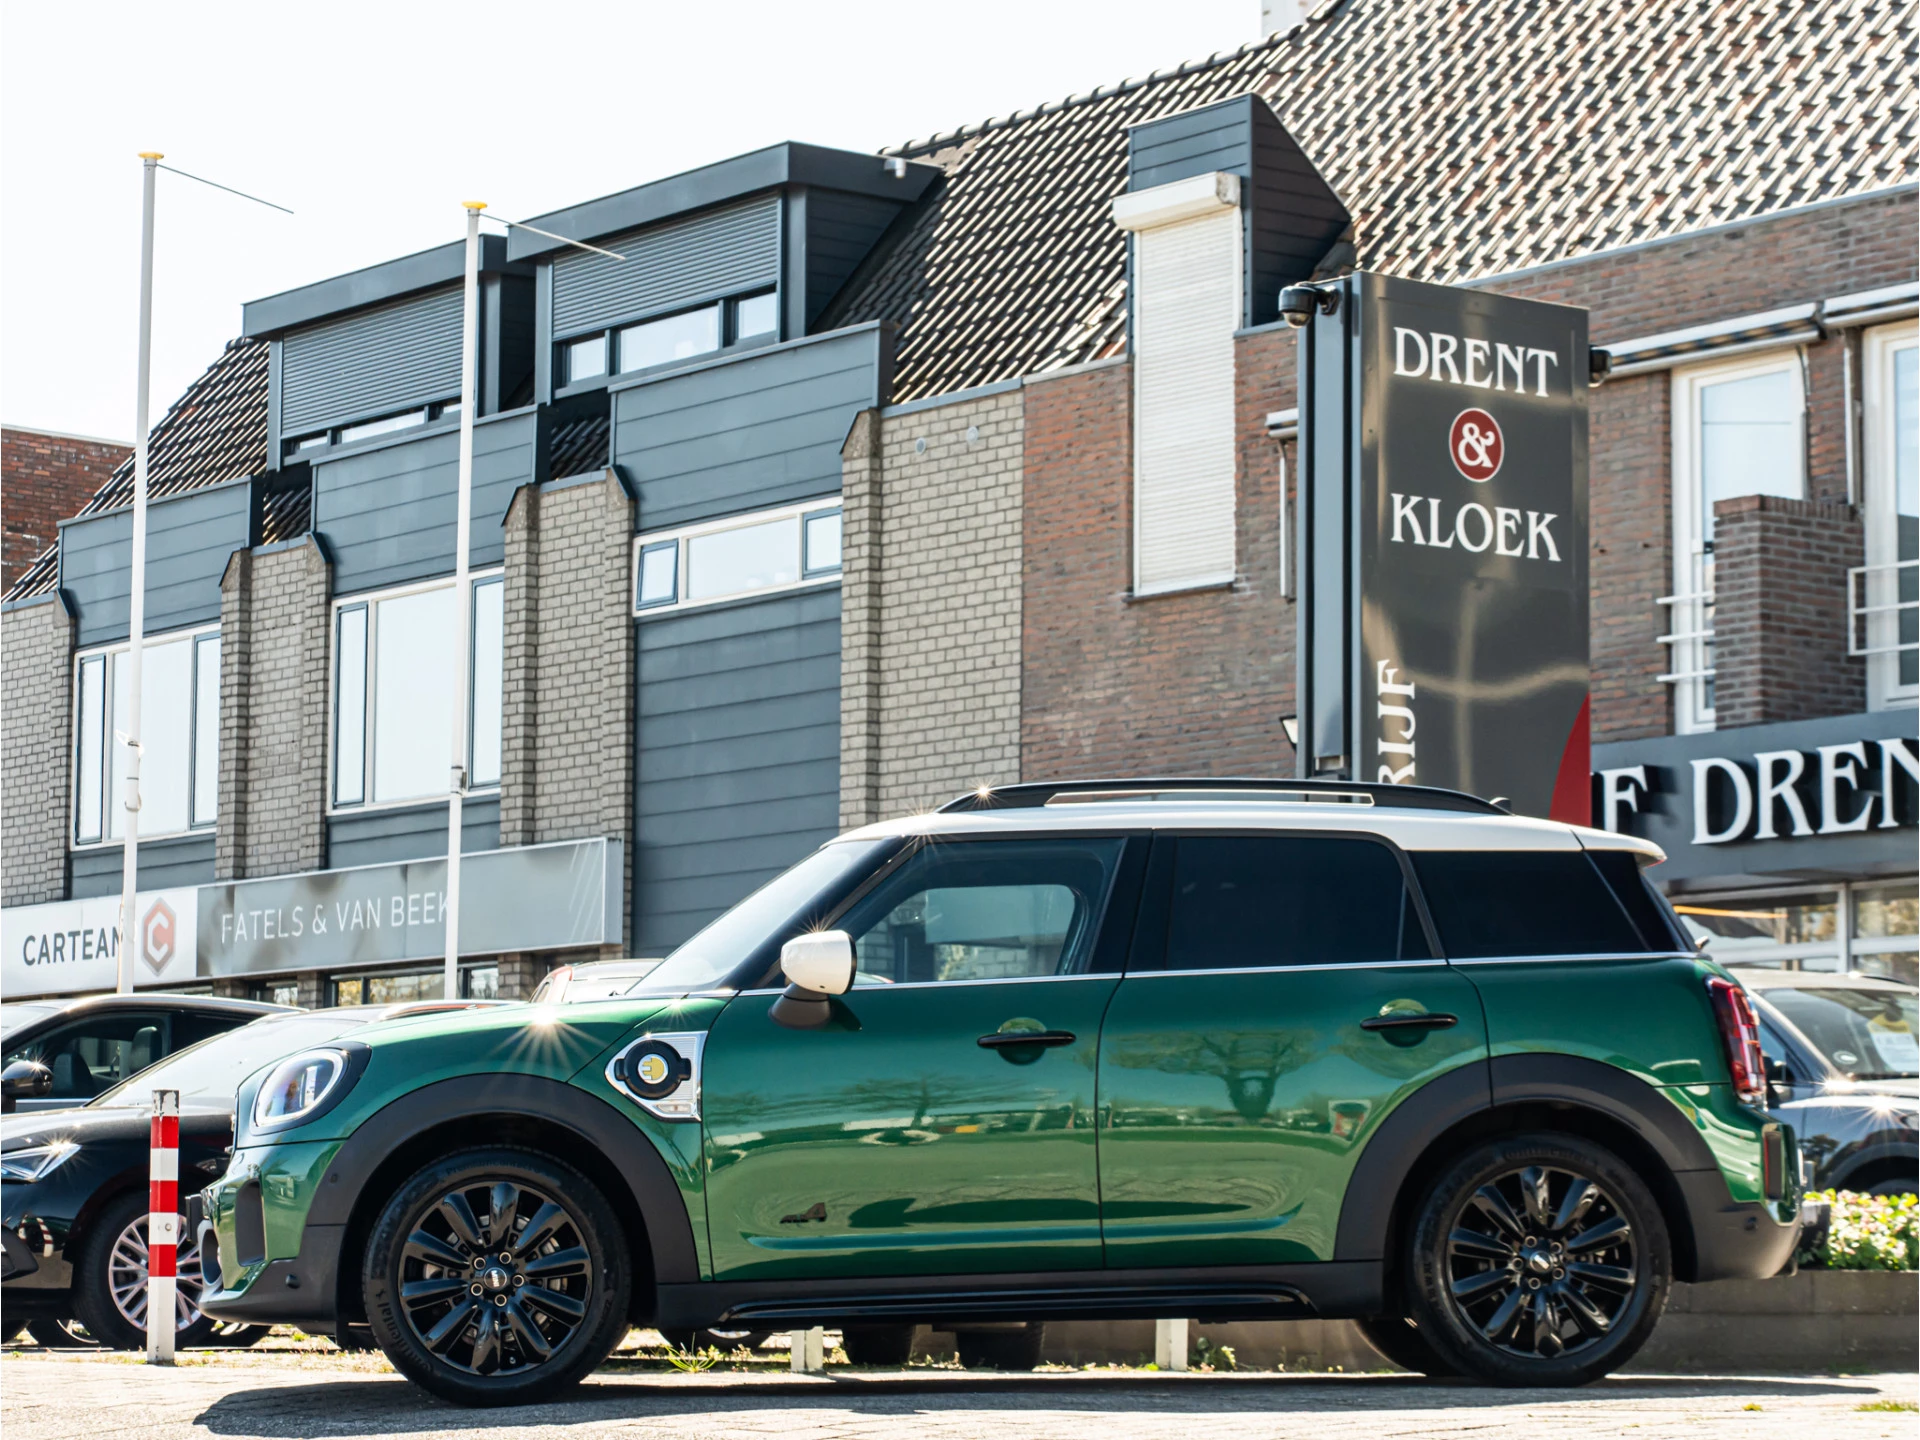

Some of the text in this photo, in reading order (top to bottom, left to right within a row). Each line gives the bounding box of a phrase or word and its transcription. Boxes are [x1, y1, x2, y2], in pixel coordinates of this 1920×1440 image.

[1393, 326, 1558, 397] DRENT
[1458, 422, 1496, 468] &
[1390, 493, 1562, 562] KLOEK
[1590, 738, 1919, 844] F DREN
[221, 892, 448, 944] FATELS & VAN BEEK
